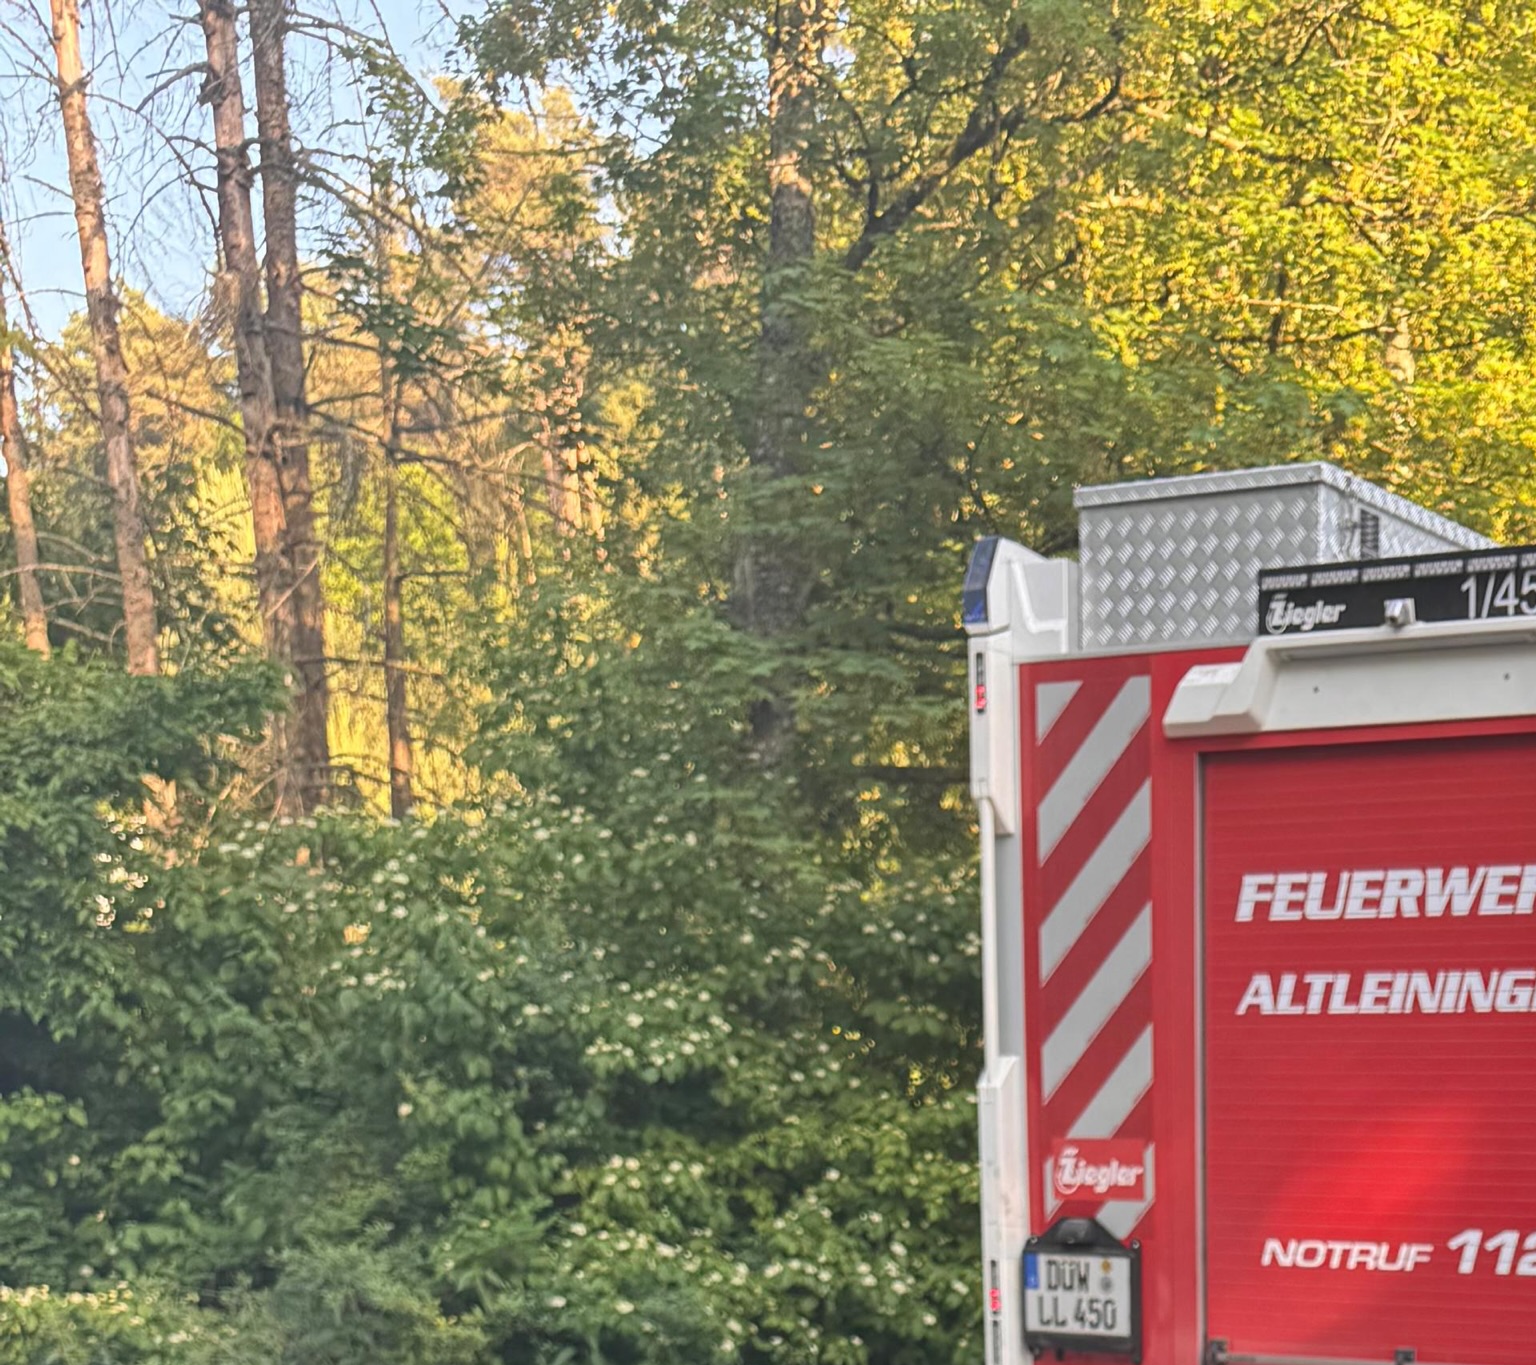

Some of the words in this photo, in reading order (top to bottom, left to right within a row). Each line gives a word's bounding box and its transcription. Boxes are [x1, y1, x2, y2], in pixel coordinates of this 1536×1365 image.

[1053, 1145, 1145, 1195] Ziegler
[1260, 1237, 1434, 1272] NOTRUF
[1045, 1258, 1091, 1292] DÜW
[1038, 1295, 1067, 1327] LL
[1073, 1298, 1118, 1331] 450
